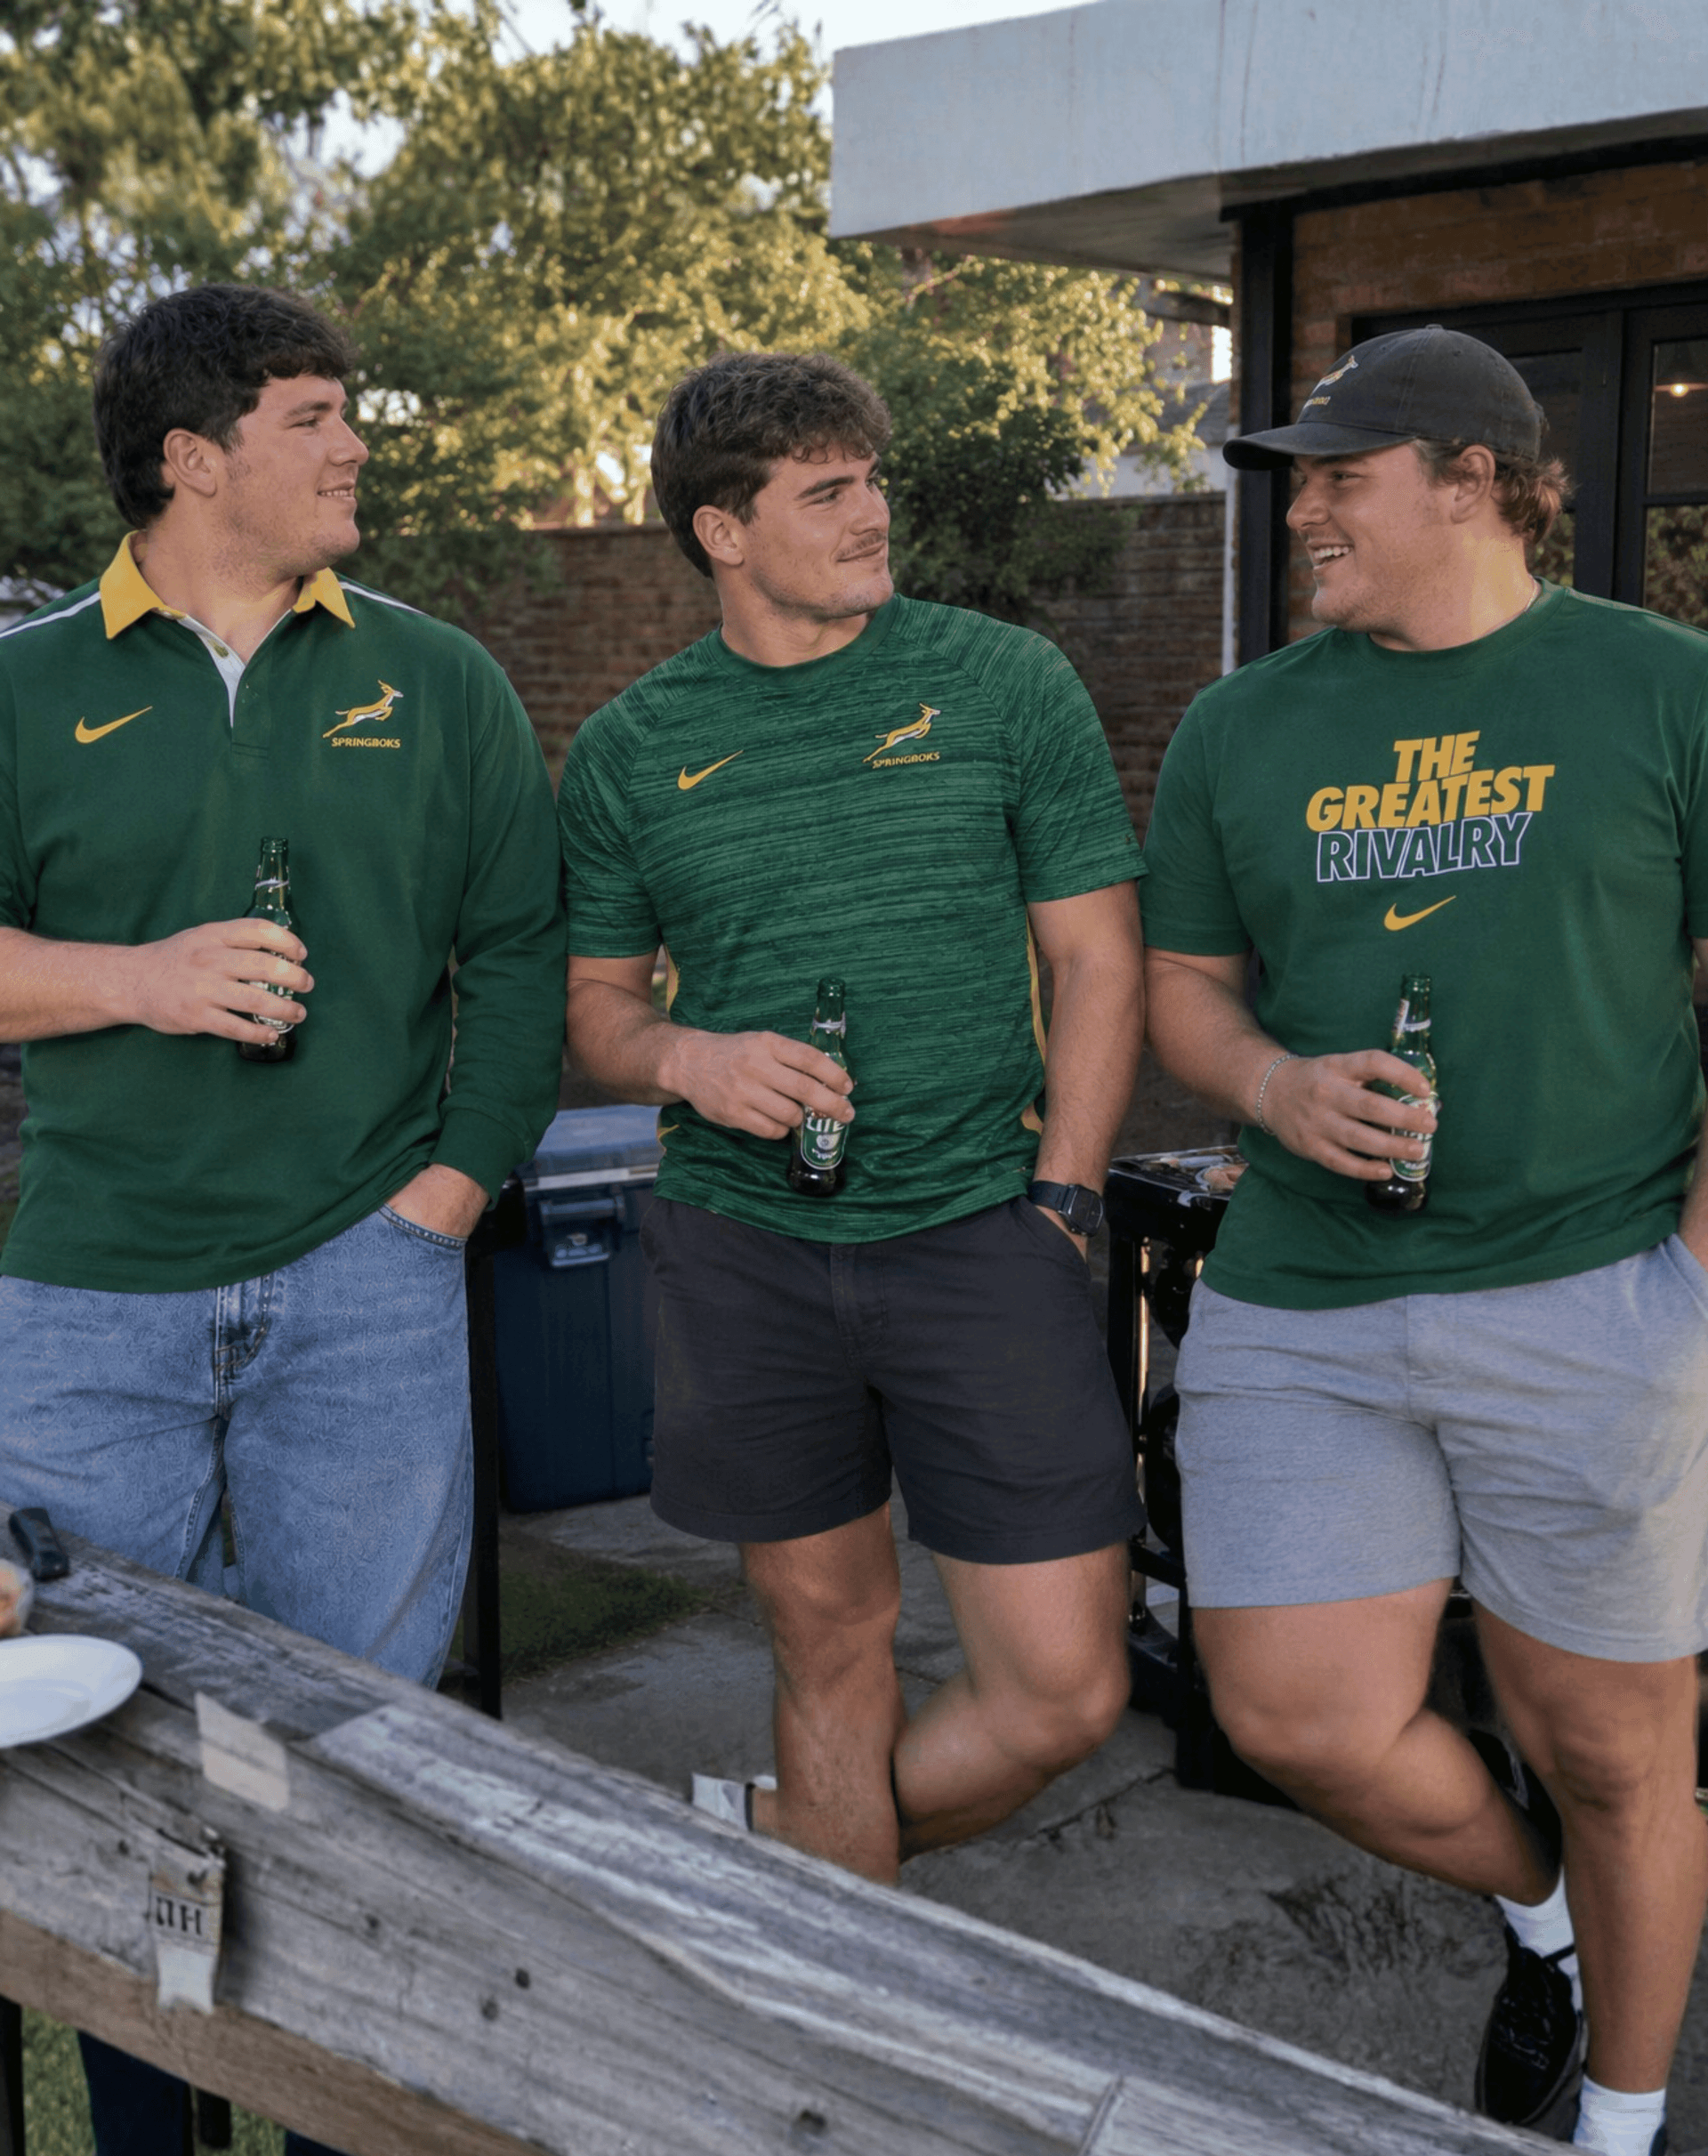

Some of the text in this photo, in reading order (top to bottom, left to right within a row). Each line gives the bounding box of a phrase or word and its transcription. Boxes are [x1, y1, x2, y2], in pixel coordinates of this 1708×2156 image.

[331, 737, 401, 748] SPRINGBOKS
[1393, 730, 1480, 783] THE
[1305, 764, 1556, 832] GREATEST
[1317, 812, 1533, 882] RIVALRY
